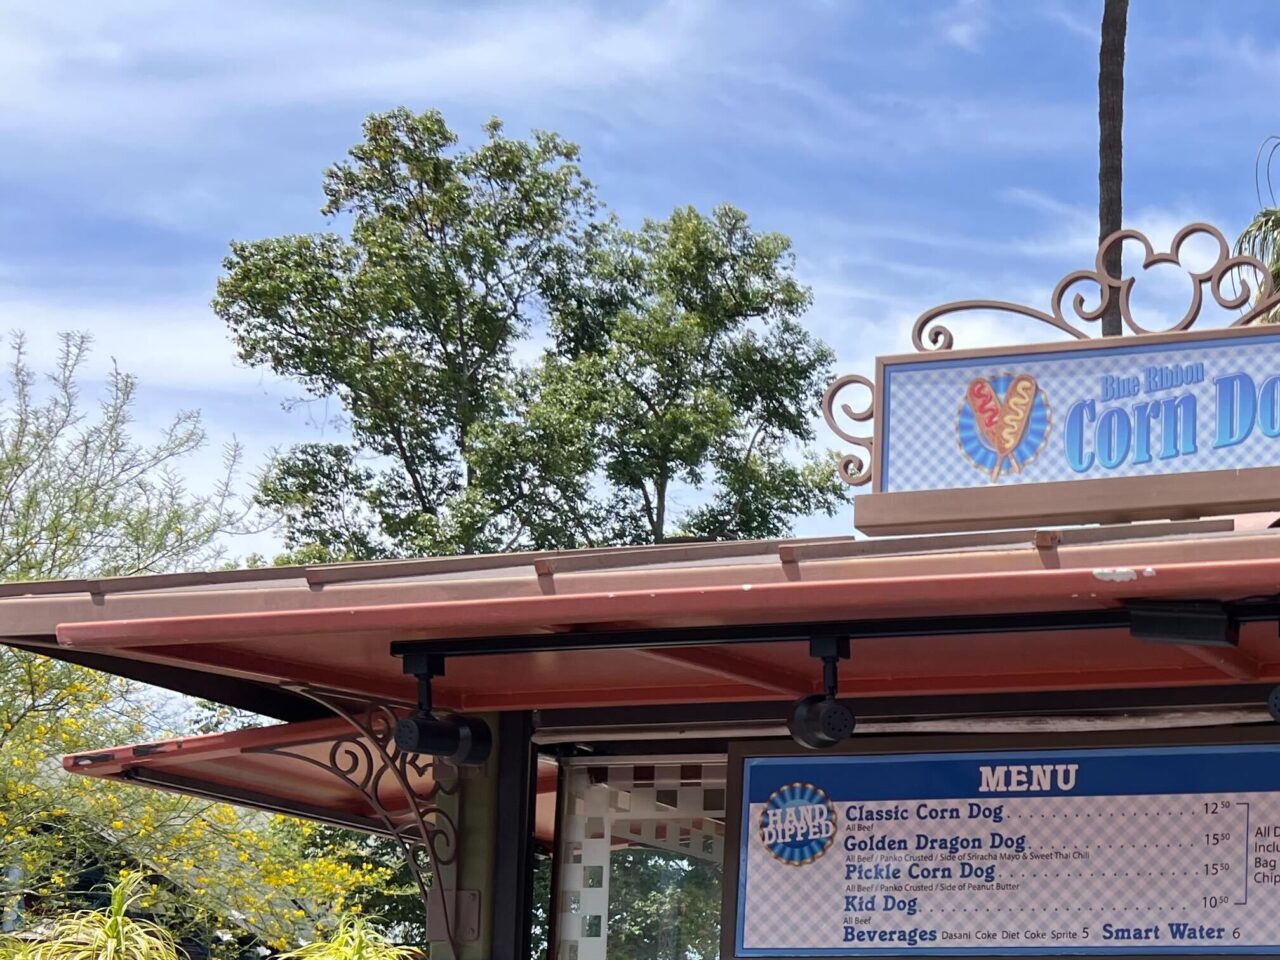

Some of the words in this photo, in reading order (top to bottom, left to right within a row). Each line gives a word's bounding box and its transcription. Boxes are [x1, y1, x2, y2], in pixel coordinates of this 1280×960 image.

[1101, 373, 1139, 401] Blue
[1144, 361, 1204, 393] Ribbon
[1063, 393, 1198, 473] Corn
[978, 764, 1079, 792] MENU
[767, 804, 828, 829] HAND
[846, 805, 909, 821] Classic
[916, 803, 960, 820] Corn
[968, 803, 1004, 823] Dog
[763, 820, 834, 844] DIPPED
[846, 824, 856, 832] All
[857, 824, 874, 832] Beef
[1255, 826, 1269, 838] All
[844, 834, 908, 851] Golden
[916, 834, 982, 854] Dragon
[990, 833, 1026, 853] Dog
[857, 854, 874, 863] Beef
[880, 854, 902, 862] Panko
[905, 854, 933, 862] Crusted
[958, 853, 967, 861] of
[967, 853, 998, 861] Sriracha
[1000, 852, 1020, 861] Mayo
[1030, 852, 1053, 860] Sweet
[1055, 851, 1070, 859] Thai
[1072, 851, 1090, 859] Chili
[1254, 857, 1276, 871] Bag
[845, 864, 901, 880] Pickle
[908, 863, 952, 879] Corn
[960, 862, 995, 882] Dog
[857, 884, 874, 892] Beef
[880, 884, 902, 892] Panko
[905, 884, 933, 892] Crusted
[940, 883, 956, 891] Side
[958, 883, 967, 891] of
[967, 883, 994, 891] Peanut
[844, 895, 876, 912] Kid
[883, 895, 918, 916] Dog
[843, 926, 937, 946] Beverages
[942, 931, 971, 940] Dasani
[975, 930, 998, 939] Coke
[1002, 930, 1020, 939] Diet
[1024, 930, 1047, 939] Coke
[1051, 930, 1078, 941] Sprite
[1082, 927, 1089, 939] 5
[1102, 923, 1161, 941] Smart
[1168, 922, 1226, 940] Water
[1232, 927, 1241, 940] 6
